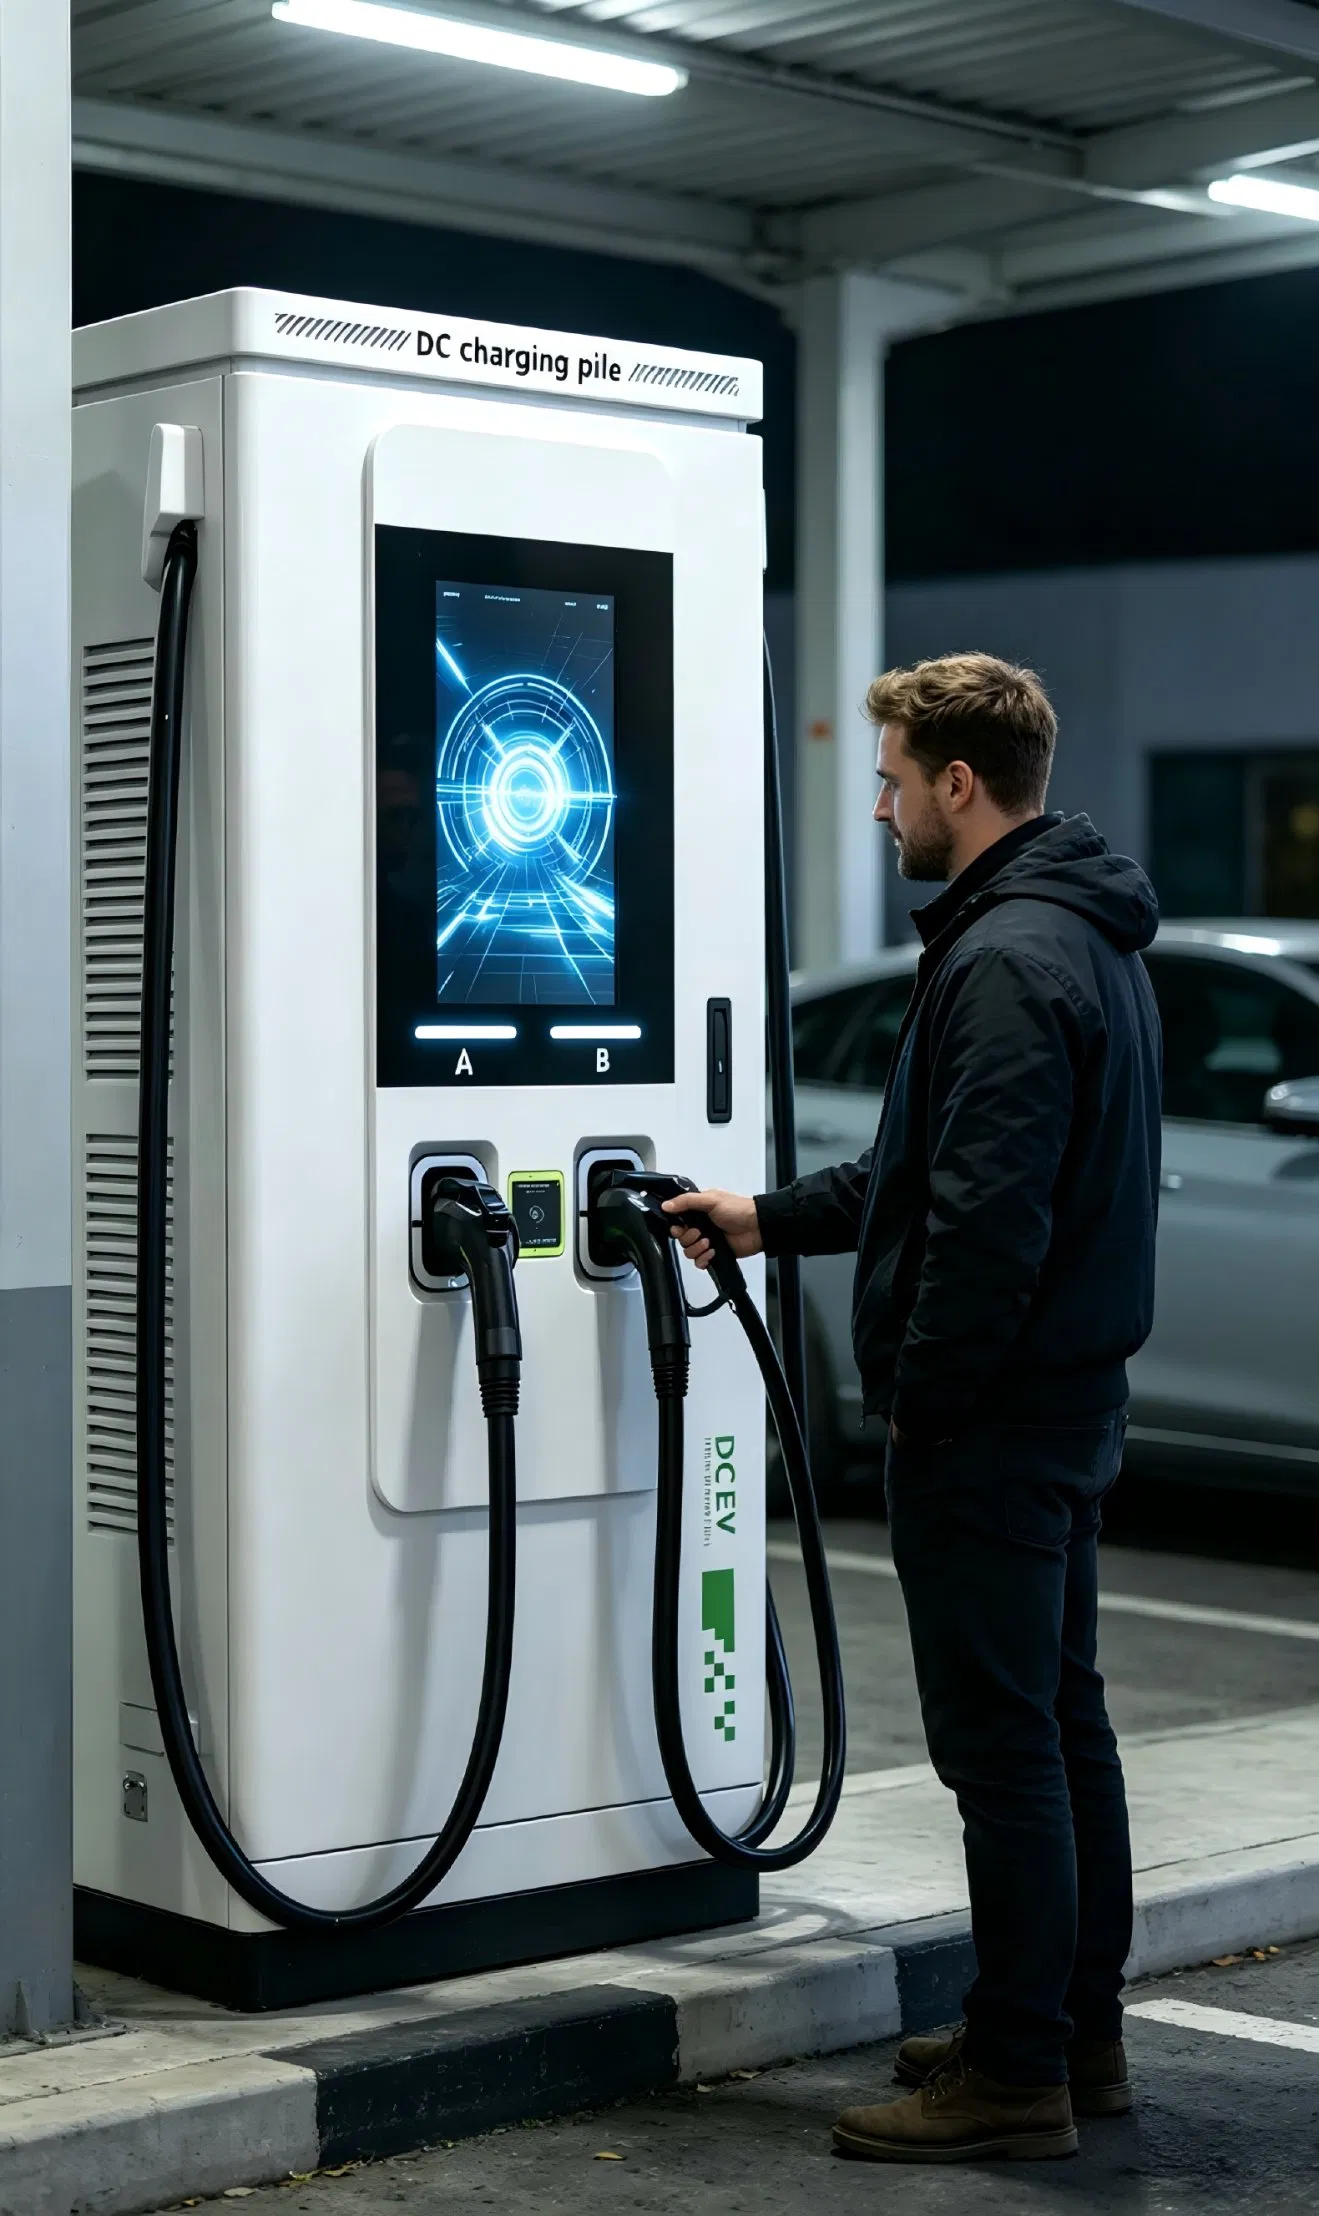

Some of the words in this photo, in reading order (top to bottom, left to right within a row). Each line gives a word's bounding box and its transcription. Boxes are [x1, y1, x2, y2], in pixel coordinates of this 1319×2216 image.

[417, 330, 451, 359] DC
[459, 336, 569, 382] charging
[578, 351, 621, 385] pile
[454, 1047, 474, 1076] A
[596, 1047, 610, 1073] B
